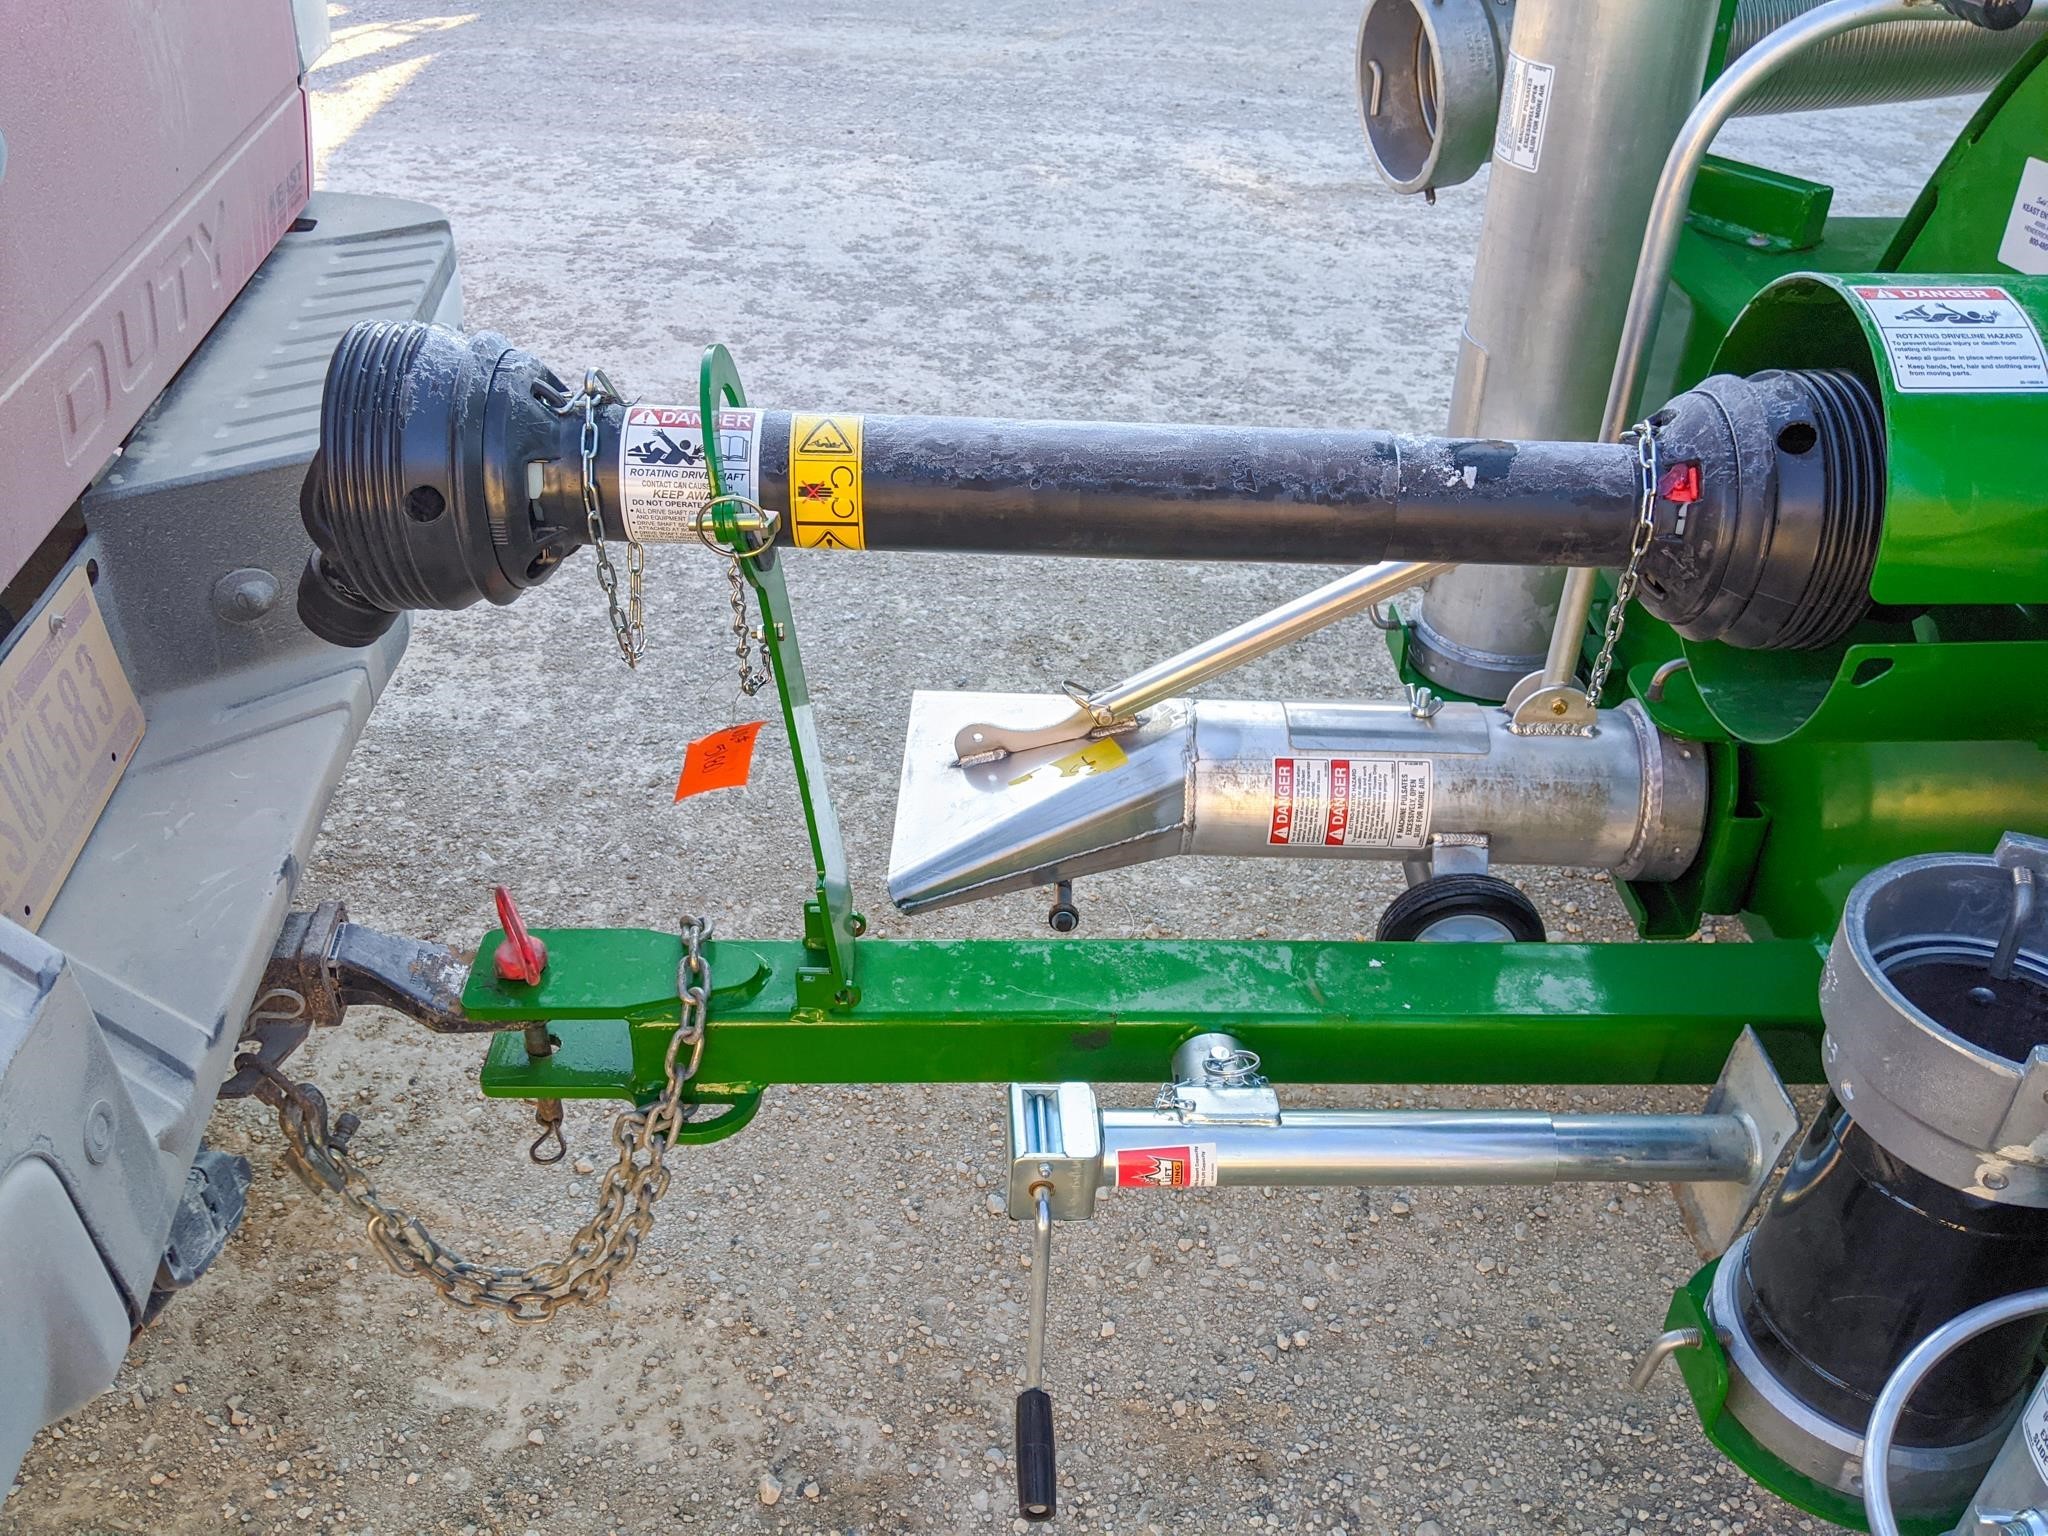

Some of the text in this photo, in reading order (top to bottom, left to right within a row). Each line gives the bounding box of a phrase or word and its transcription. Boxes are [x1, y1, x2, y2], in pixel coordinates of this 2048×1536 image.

[1901, 289, 1990, 299] DANGER
[55, 200, 226, 467] DUTY
[661, 411, 751, 427] DANER
[630, 468, 679, 478] ROTATING
[642, 480, 672, 488] CONTACT
[674, 481, 687, 489] CAN
[653, 489, 712, 501] KEEP AWA
[665, 500, 702, 508] OPERATE
[1400, 774, 1408, 805] PULSATES
[1408, 779, 1416, 797] OPEN
[1417, 775, 1425, 789] AIR.
[1276, 766, 1291, 824] DANGER
[1331, 767, 1346, 824] DANGER
[1398, 806, 1407, 833] MACHINE
[1415, 811, 1423, 822] FOR
[1413, 823, 1422, 838] SLIDE
[1164, 1166, 1172, 1183] LIFT
